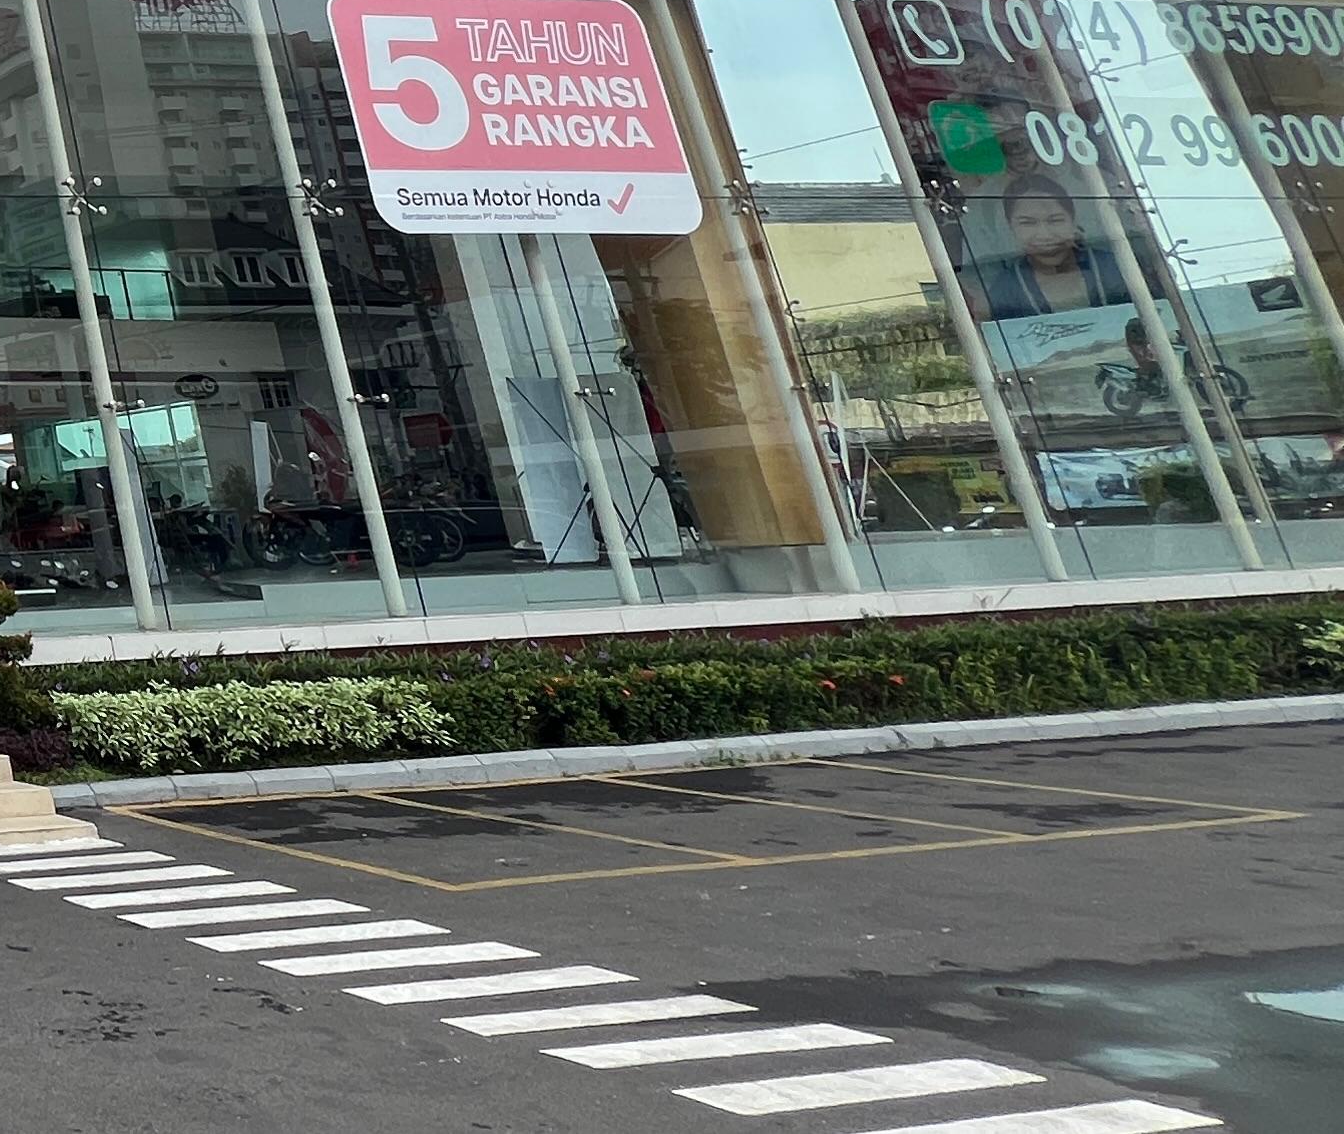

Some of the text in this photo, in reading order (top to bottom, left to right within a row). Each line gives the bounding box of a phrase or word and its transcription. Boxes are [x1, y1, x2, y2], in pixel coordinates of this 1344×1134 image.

[455, 17, 630, 66] TAHUN
[361, 14, 470, 152] 5
[472, 72, 649, 109] GARANSI
[481, 113, 656, 149] RANGKA
[1025, 111, 1166, 166] 082
[1250, 114, 1344, 167] 600
[397, 187, 601, 208] Semua Motor Honda
